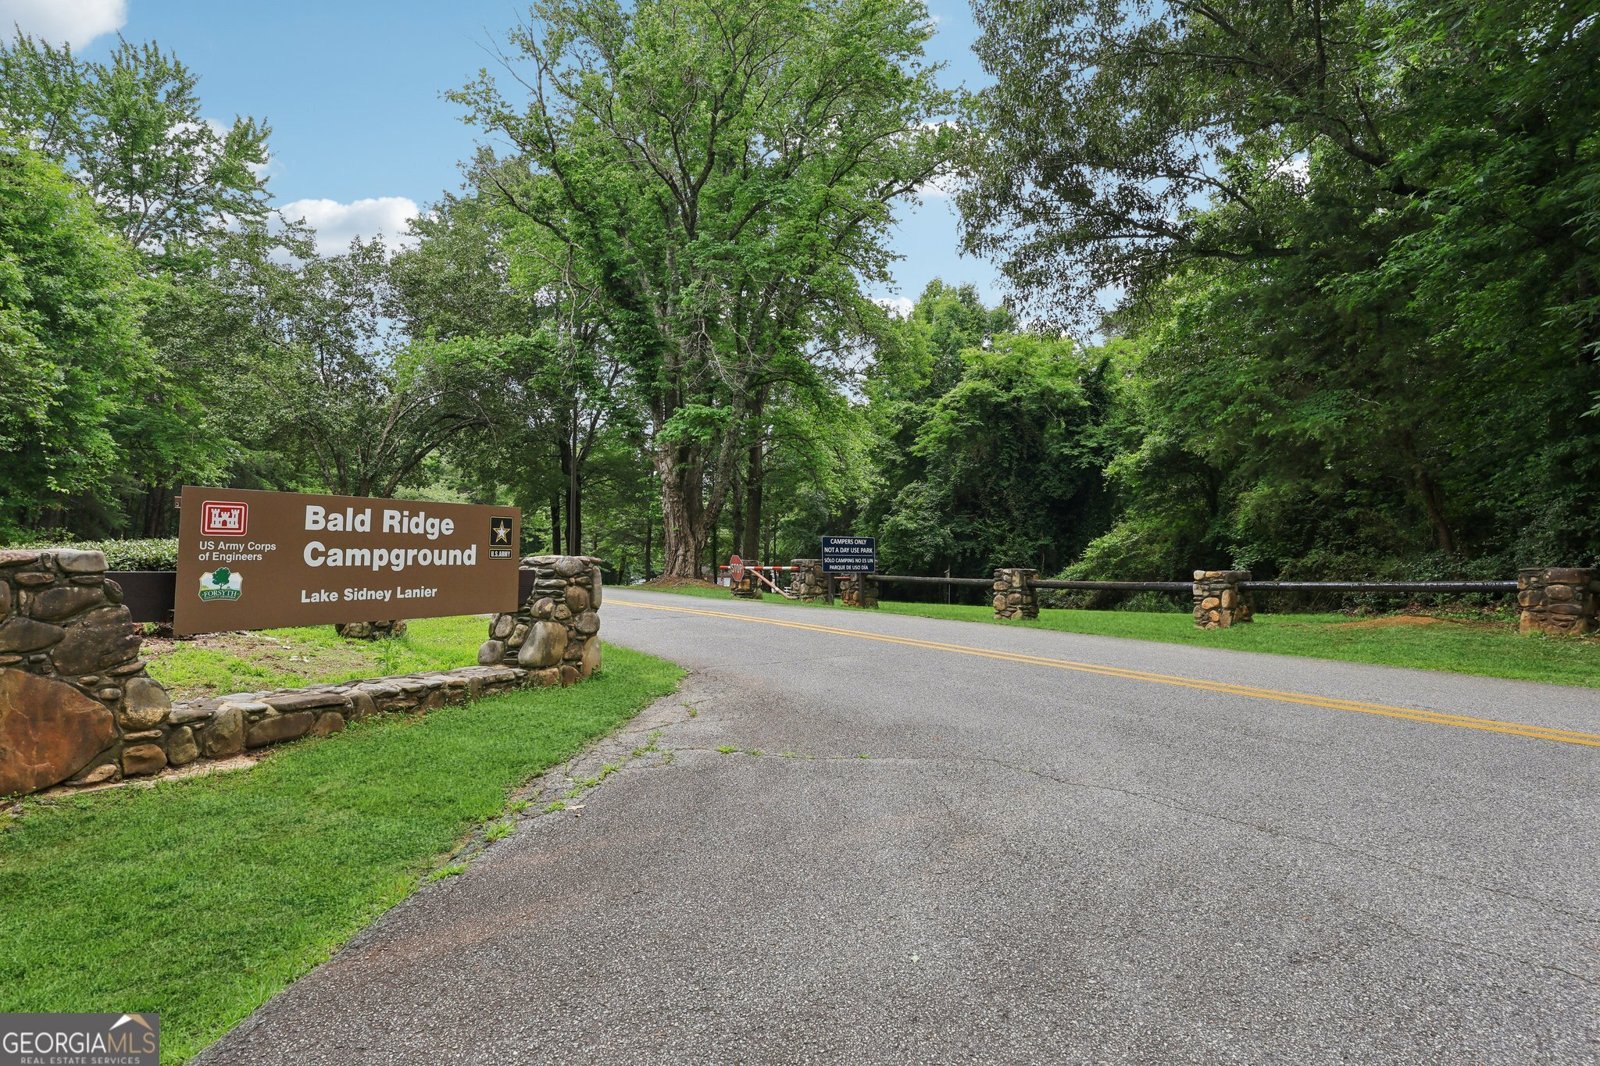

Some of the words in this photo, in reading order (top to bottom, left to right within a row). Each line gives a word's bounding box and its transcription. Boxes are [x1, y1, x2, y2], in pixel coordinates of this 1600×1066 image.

[304, 504, 372, 533] Bald
[382, 509, 455, 540] Ridge
[199, 541, 214, 550] US
[218, 541, 244, 552] Army
[248, 542, 276, 552] Corps
[198, 552, 210, 560] of
[212, 552, 262, 562] Engineers
[303, 541, 477, 572] Campground
[730, 563, 742, 573] STOP
[204, 590, 237, 598] FORSYTH
[301, 590, 338, 603] Lake
[344, 588, 392, 602] Sidney
[396, 586, 438, 599] Lanier
